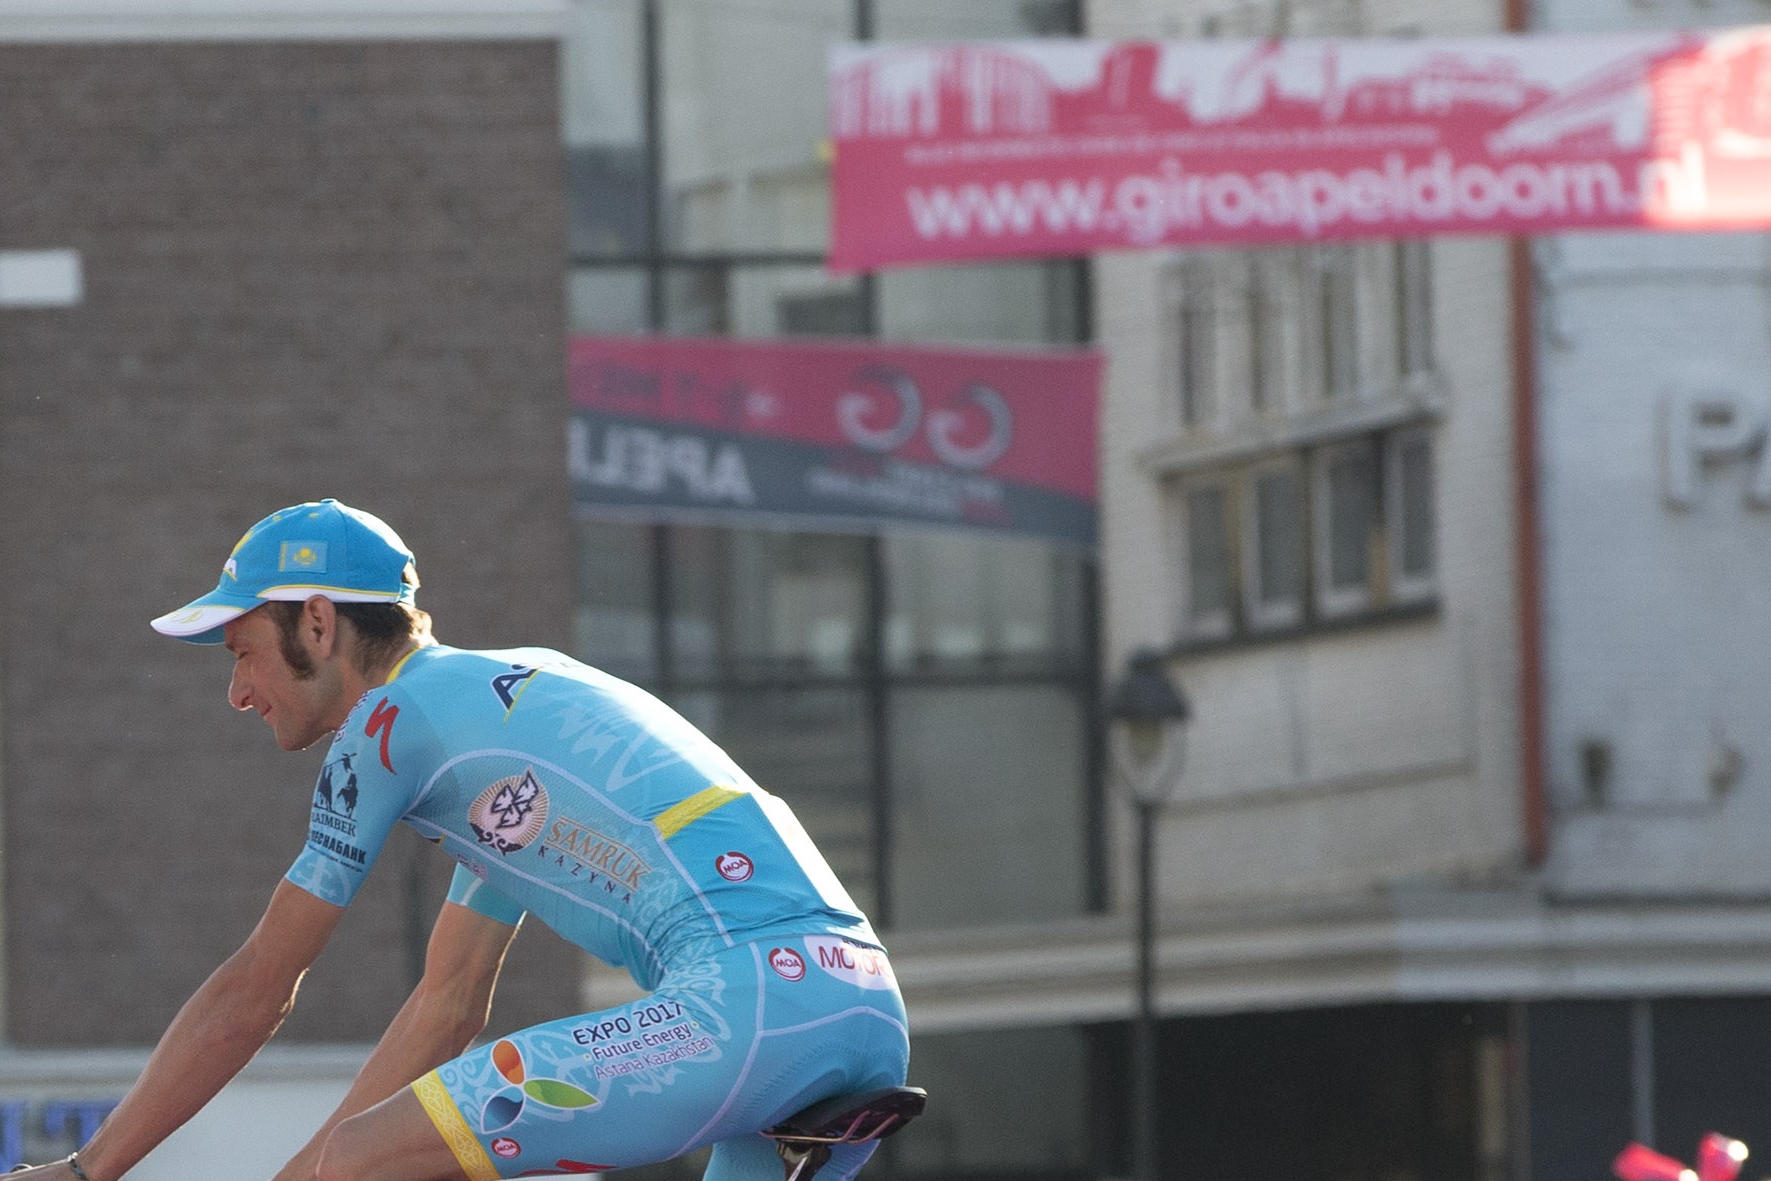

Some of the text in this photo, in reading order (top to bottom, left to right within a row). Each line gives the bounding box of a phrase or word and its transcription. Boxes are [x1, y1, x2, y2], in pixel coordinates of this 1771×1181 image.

[538, 845, 632, 904] KAZYNA
[547, 821, 648, 889] SAMRUK
[723, 859, 748, 874] MOA
[775, 957, 803, 968] MOA
[572, 1000, 683, 1046] EXPO 2017
[592, 1023, 693, 1060] Future Energy
[594, 1036, 715, 1080] Astana Kazakhstan
